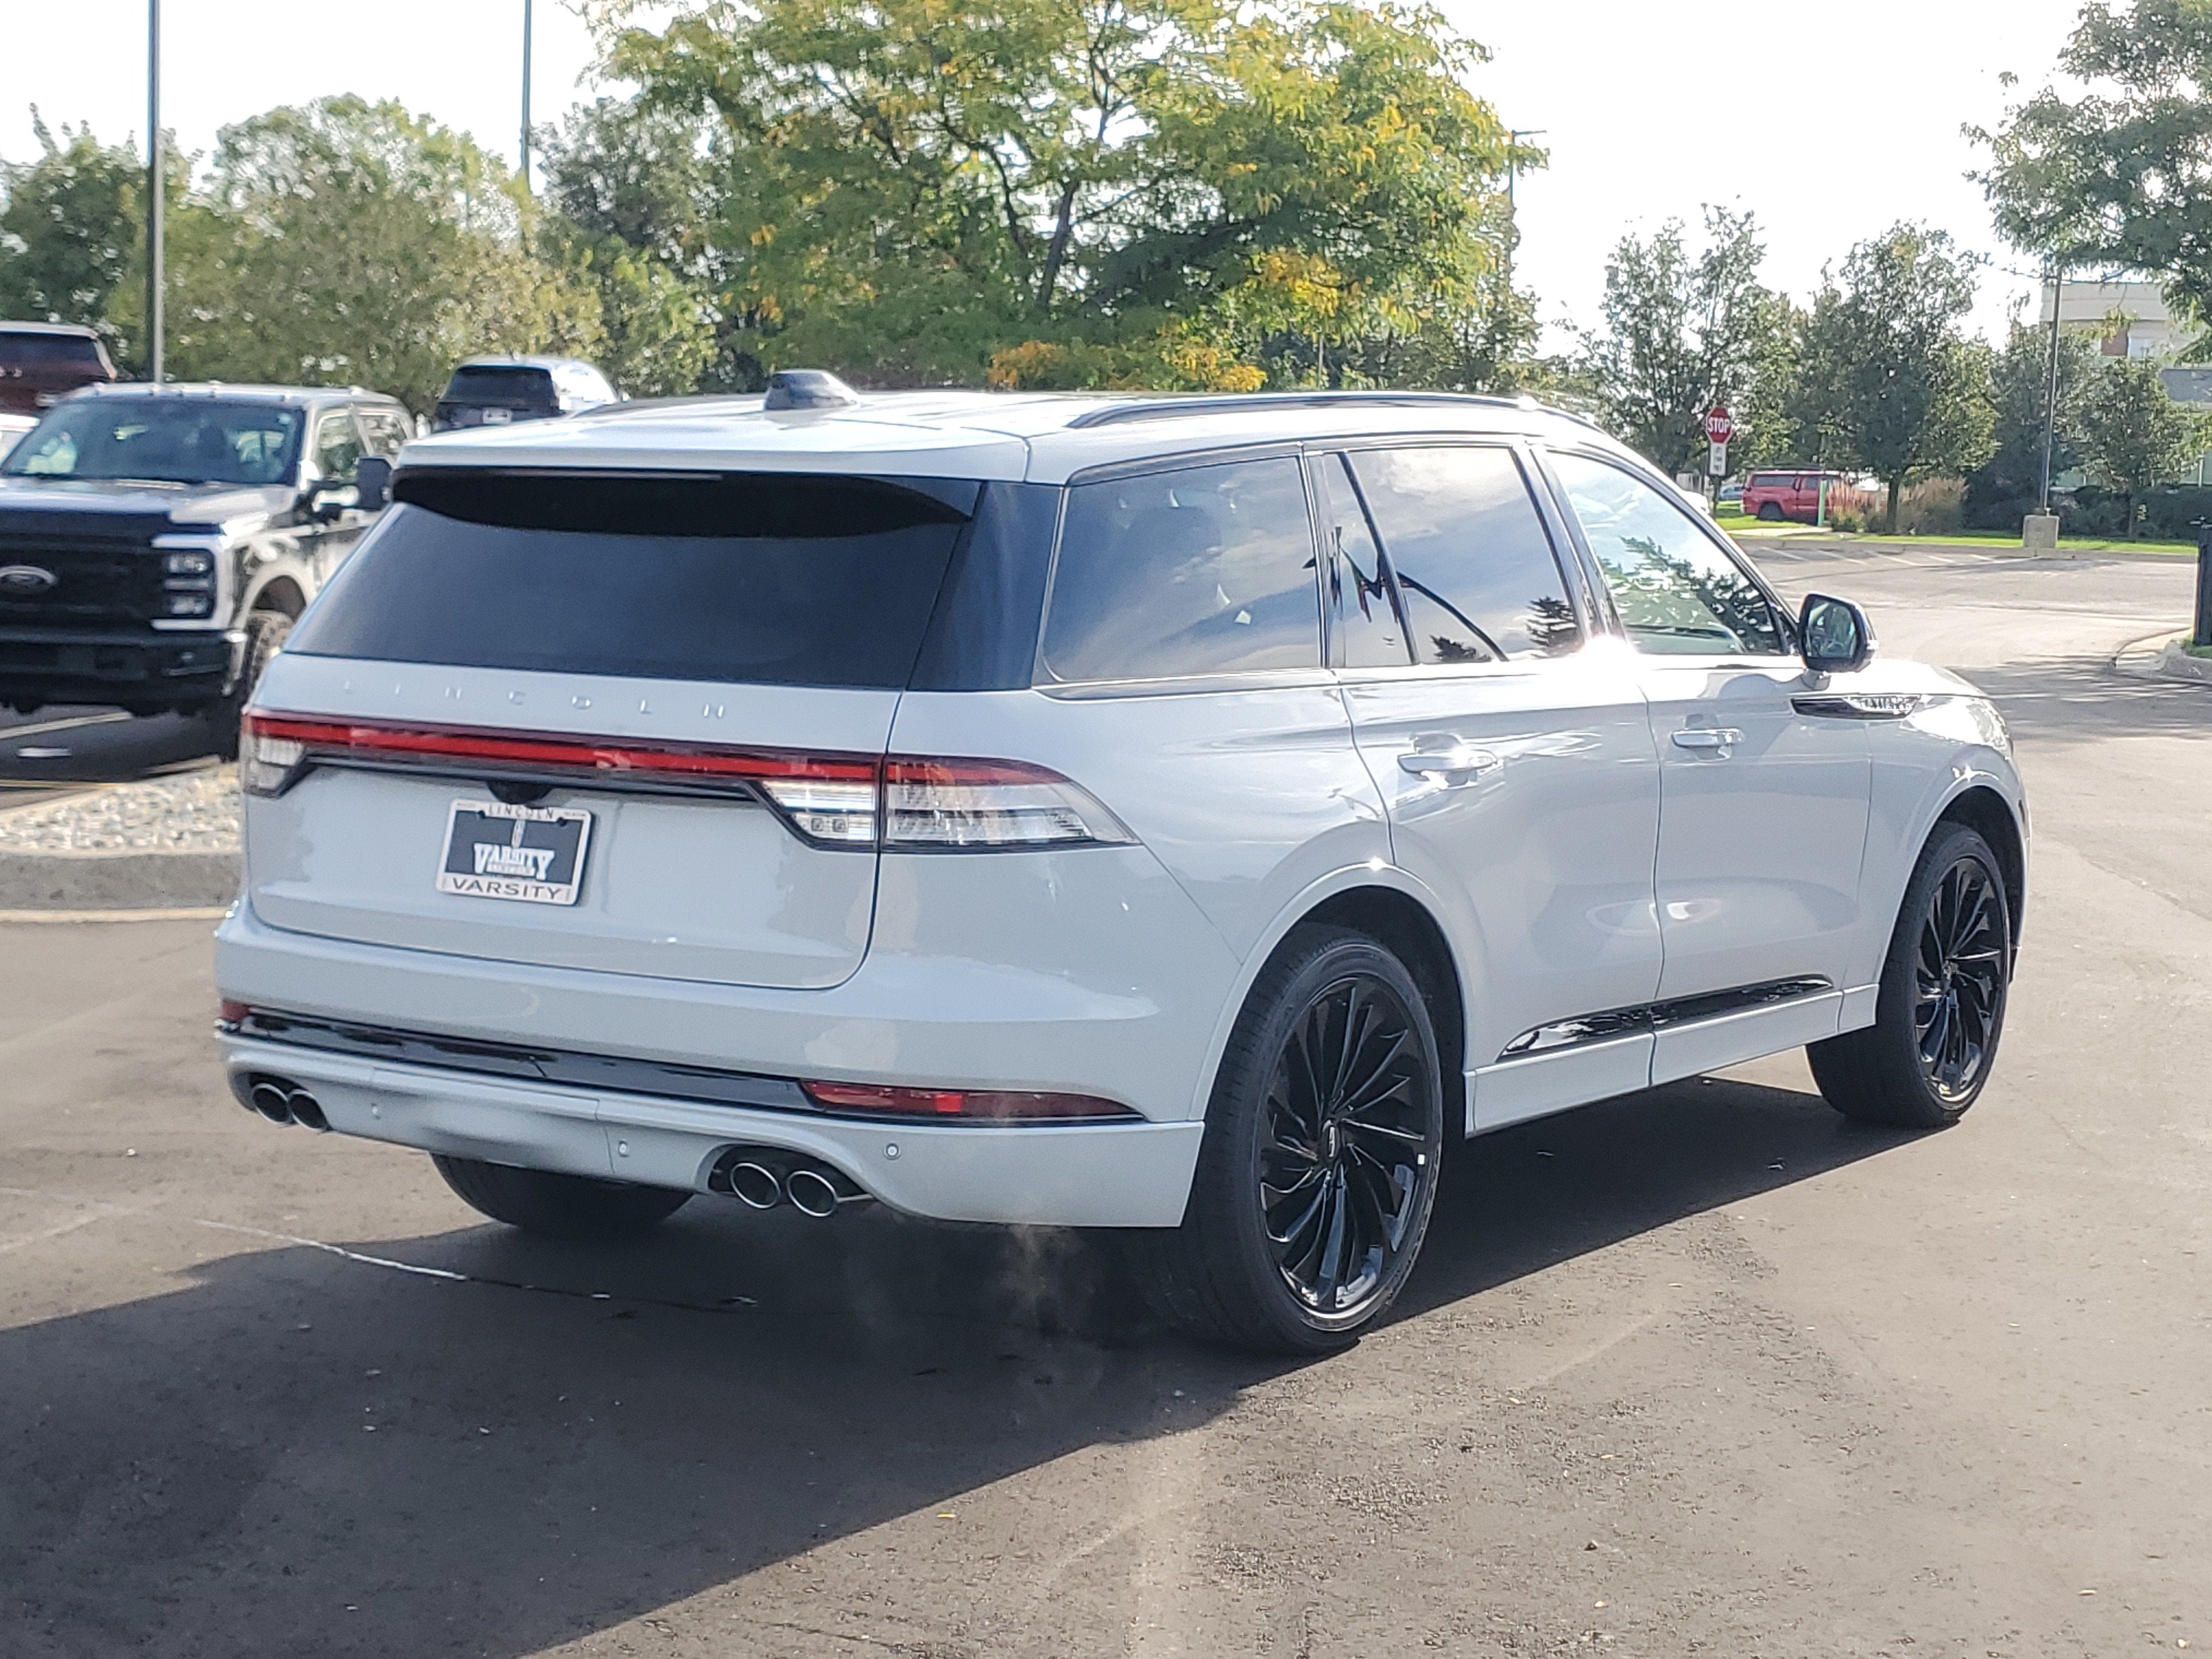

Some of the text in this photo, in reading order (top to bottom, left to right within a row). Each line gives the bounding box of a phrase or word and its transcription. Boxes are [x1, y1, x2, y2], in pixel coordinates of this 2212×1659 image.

[1708, 417, 1730, 433] STOP
[344, 680, 725, 718] LINCOLN
[474, 842, 555, 881] VARSITY
[452, 878, 561, 900] VARSITY
